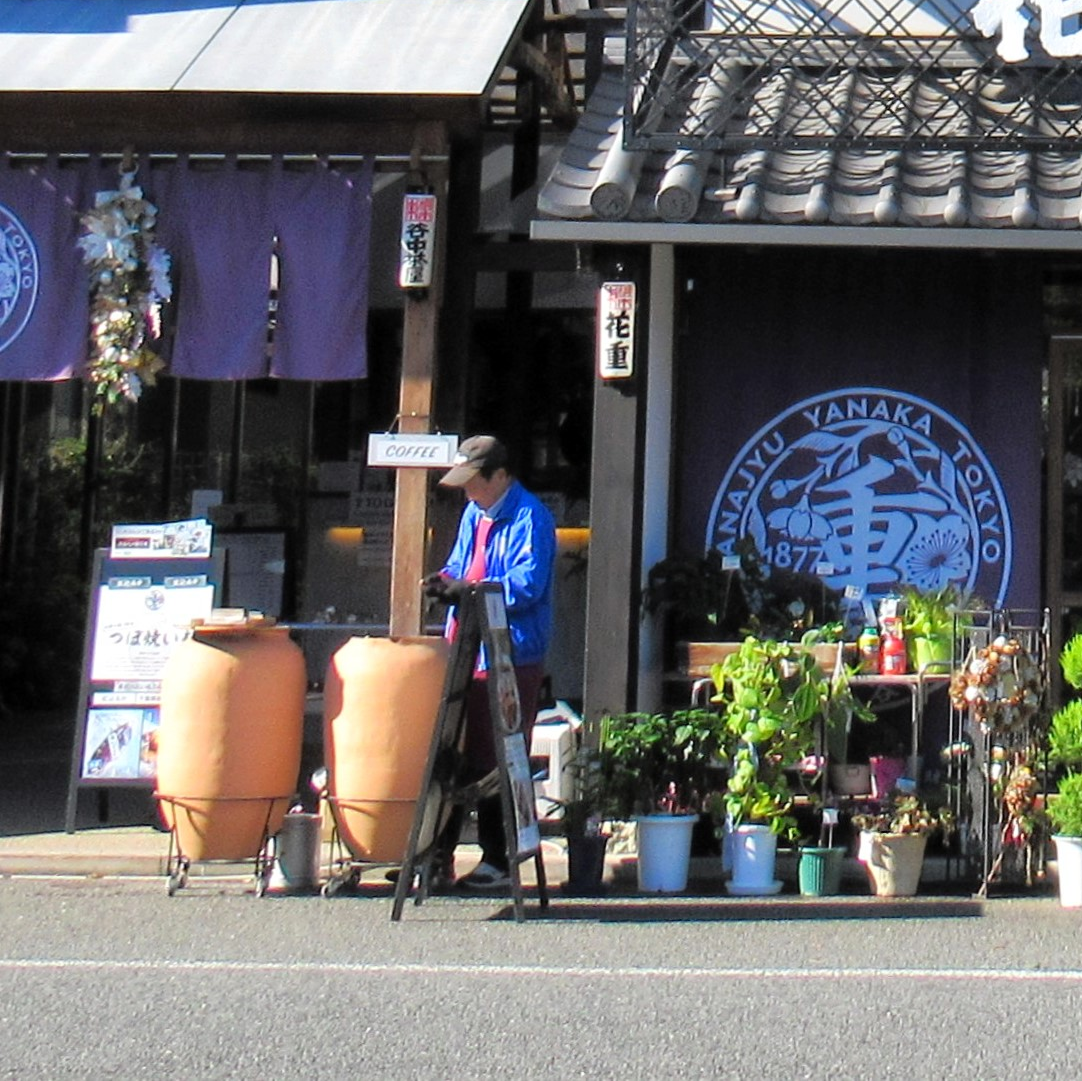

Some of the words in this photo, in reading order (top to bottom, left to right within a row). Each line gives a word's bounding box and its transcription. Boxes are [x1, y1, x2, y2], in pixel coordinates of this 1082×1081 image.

[4, 222, 33, 289] TOKYO
[604, 310, 631, 369] 花重
[385, 444, 440, 459] COFFEE
[716, 430, 785, 557] ANAJYU
[803, 398, 933, 435] YANAKA
[952, 440, 1002, 564] TOKYO
